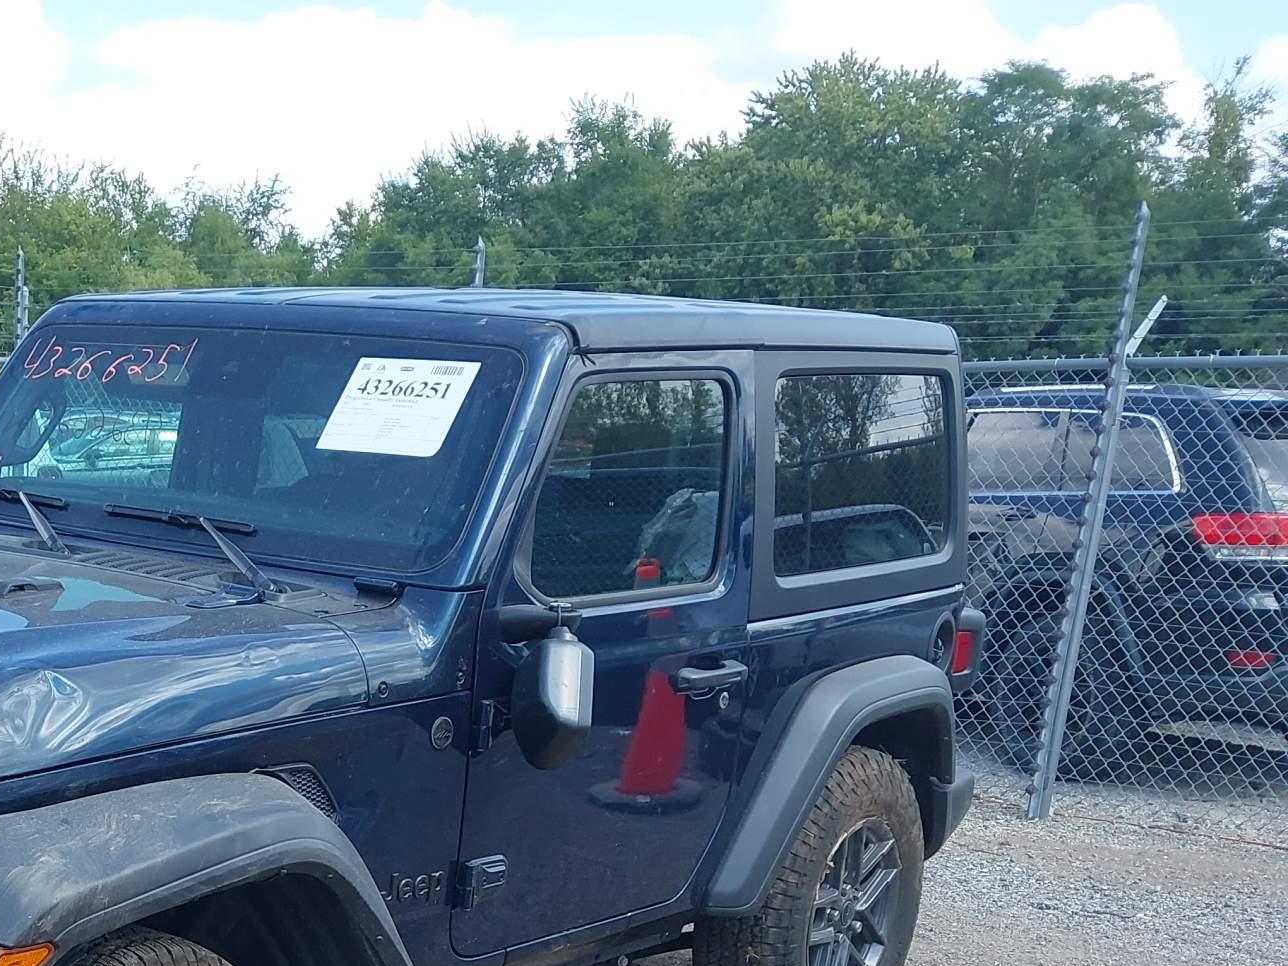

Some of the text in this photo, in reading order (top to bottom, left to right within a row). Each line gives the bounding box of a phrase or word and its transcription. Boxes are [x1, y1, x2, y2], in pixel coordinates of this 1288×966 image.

[23, 335, 199, 384] 43266251
[357, 377, 453, 400] 43266251
[380, 870, 445, 904] Jeep
